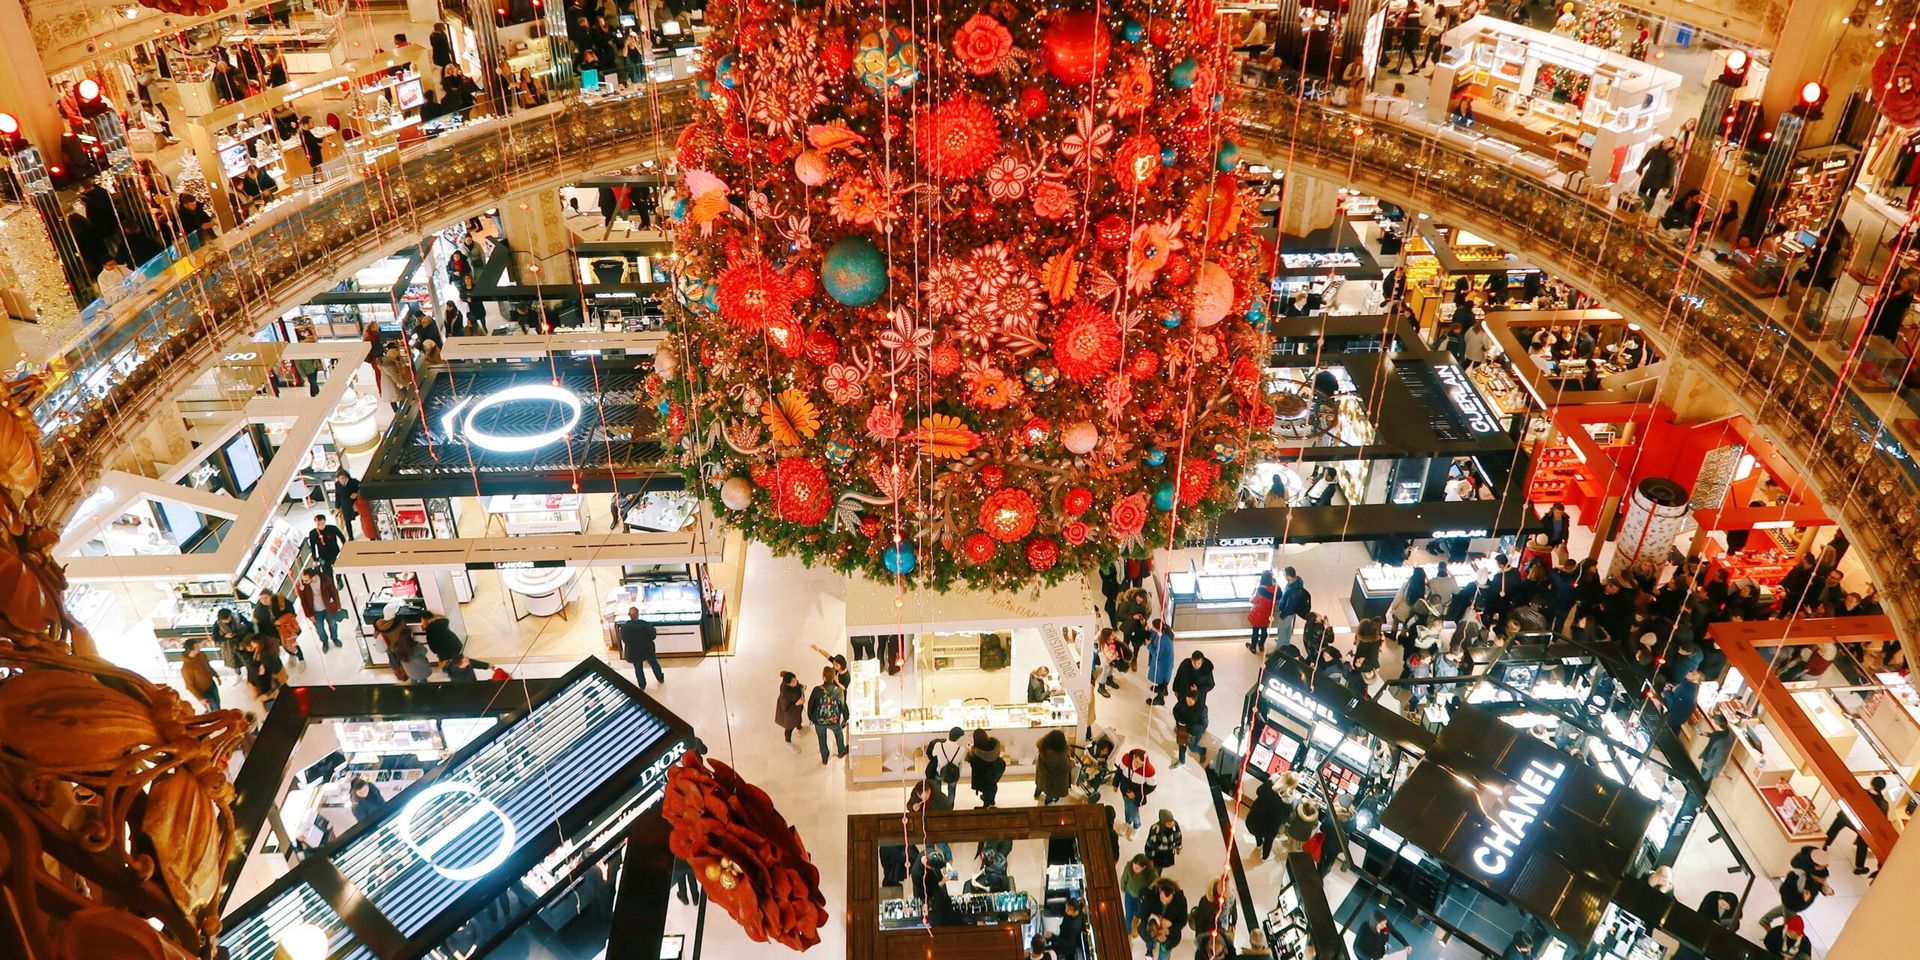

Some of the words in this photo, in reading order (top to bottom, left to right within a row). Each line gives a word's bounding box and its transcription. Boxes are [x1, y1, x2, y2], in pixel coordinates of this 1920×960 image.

[1434, 365, 1491, 432] GUERLAIN
[1219, 538, 1275, 546] GUERLAIN
[1042, 622, 1068, 662] CHRISTIAN
[1060, 660, 1076, 680] DIOR
[1268, 677, 1338, 724] CHANEL
[640, 741, 687, 786] DIOR
[1474, 760, 1566, 875] CHANEL
